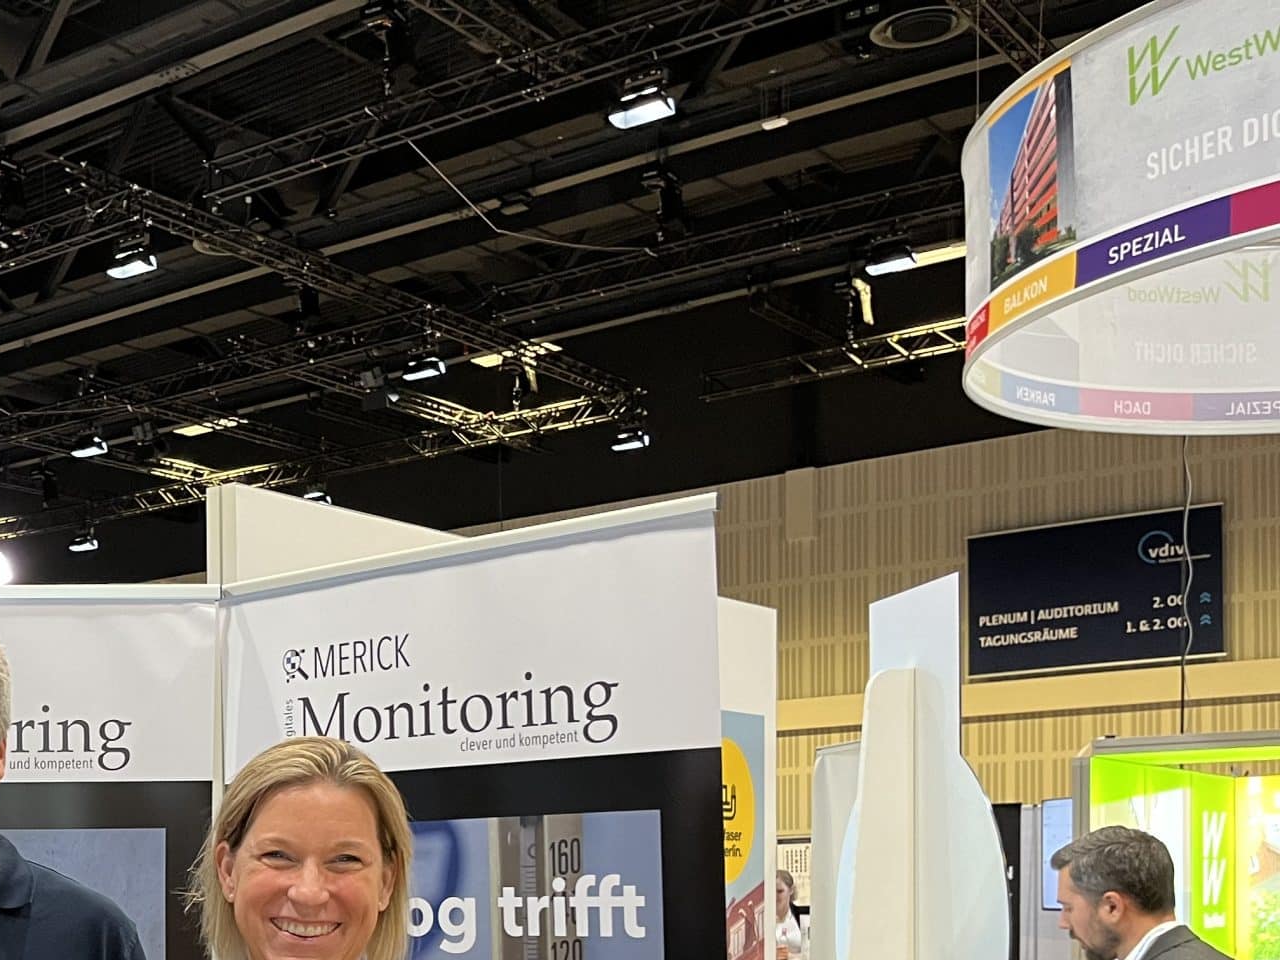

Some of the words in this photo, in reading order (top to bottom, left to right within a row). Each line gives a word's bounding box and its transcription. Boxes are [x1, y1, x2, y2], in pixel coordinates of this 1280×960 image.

[1147, 124, 1233, 180] SICHER
[1108, 224, 1186, 265] SPEZIAL
[1003, 277, 1048, 314] BALKON
[979, 608, 1028, 628] PLENUM
[1037, 600, 1120, 622] AUDITORIUM
[979, 626, 1078, 648] TAGUNGSRÄUME
[314, 633, 411, 680] MERICK
[297, 671, 620, 744] Monitoring
[460, 737, 493, 753] clever
[495, 735, 517, 750] und
[519, 730, 578, 752] kompetent
[9, 756, 31, 771] und
[33, 755, 94, 774] kompetent
[548, 838, 582, 876] 160
[497, 874, 646, 938] trifft
